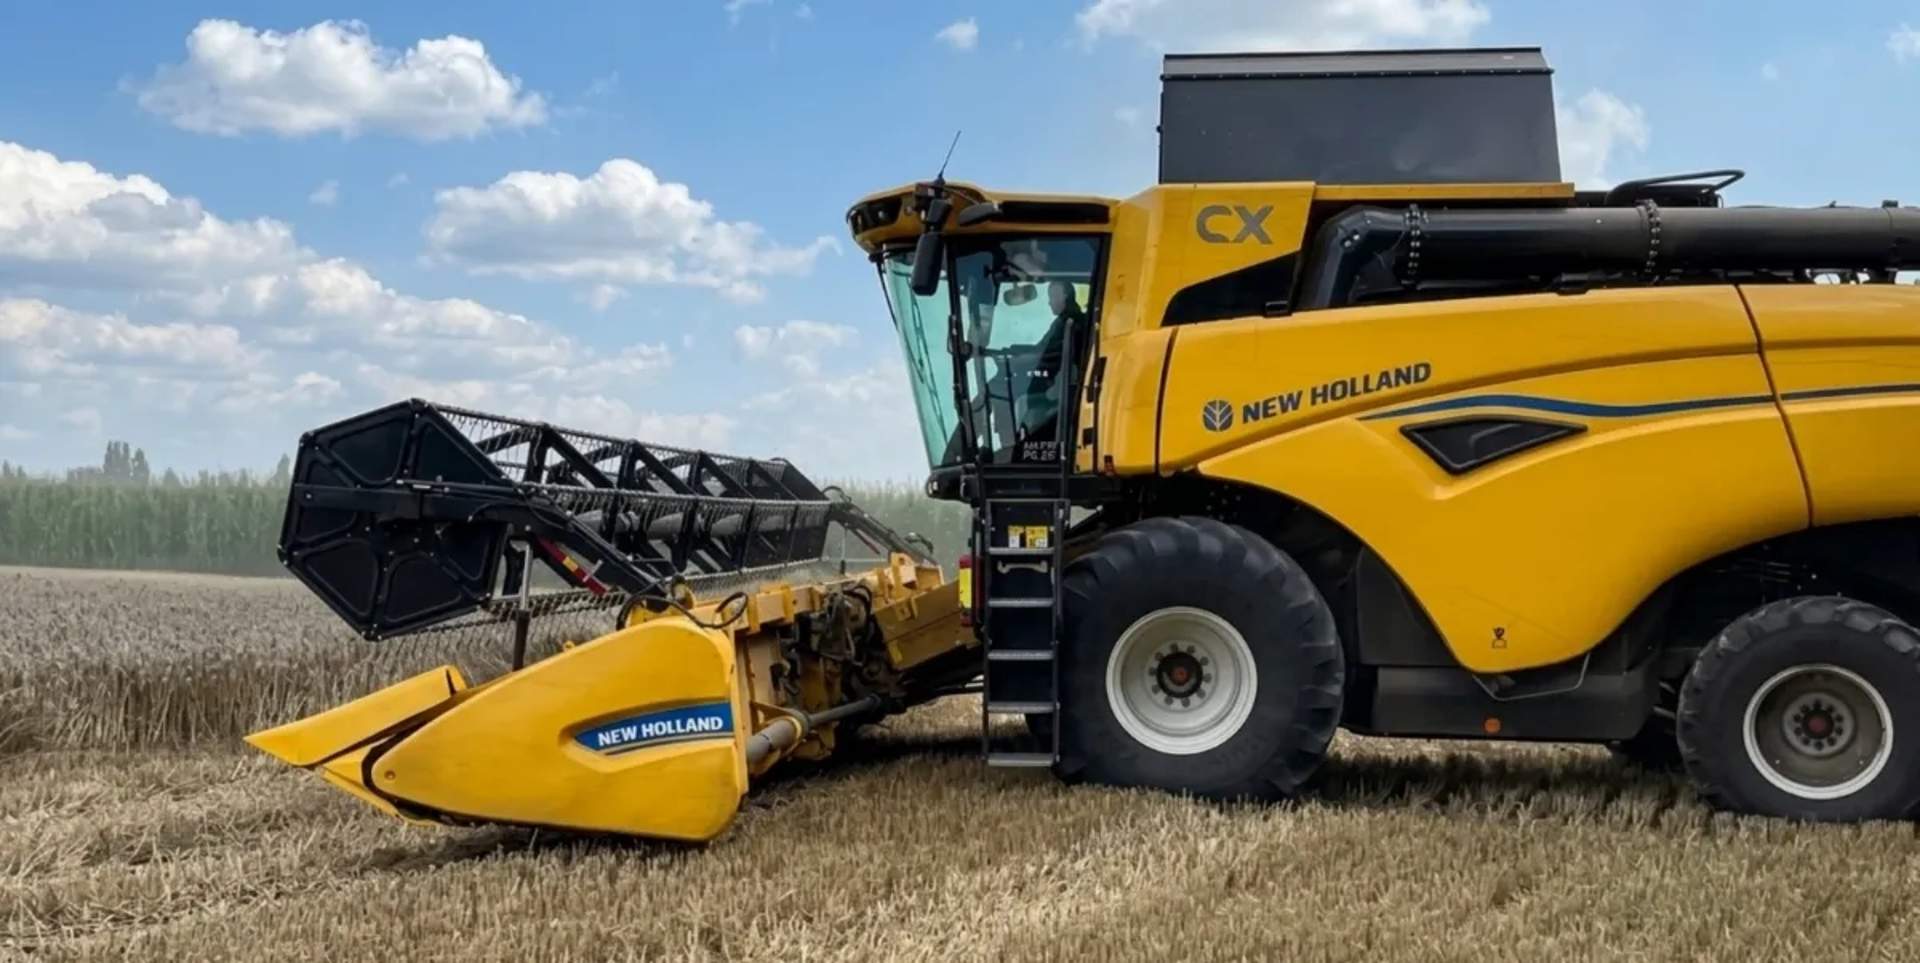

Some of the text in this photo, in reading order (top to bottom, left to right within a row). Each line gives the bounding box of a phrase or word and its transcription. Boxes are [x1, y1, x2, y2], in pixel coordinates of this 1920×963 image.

[1196, 204, 1274, 245] CX
[1242, 362, 1432, 424] NEW HOLLAND
[597, 716, 724, 747] NEW HOLLAND
